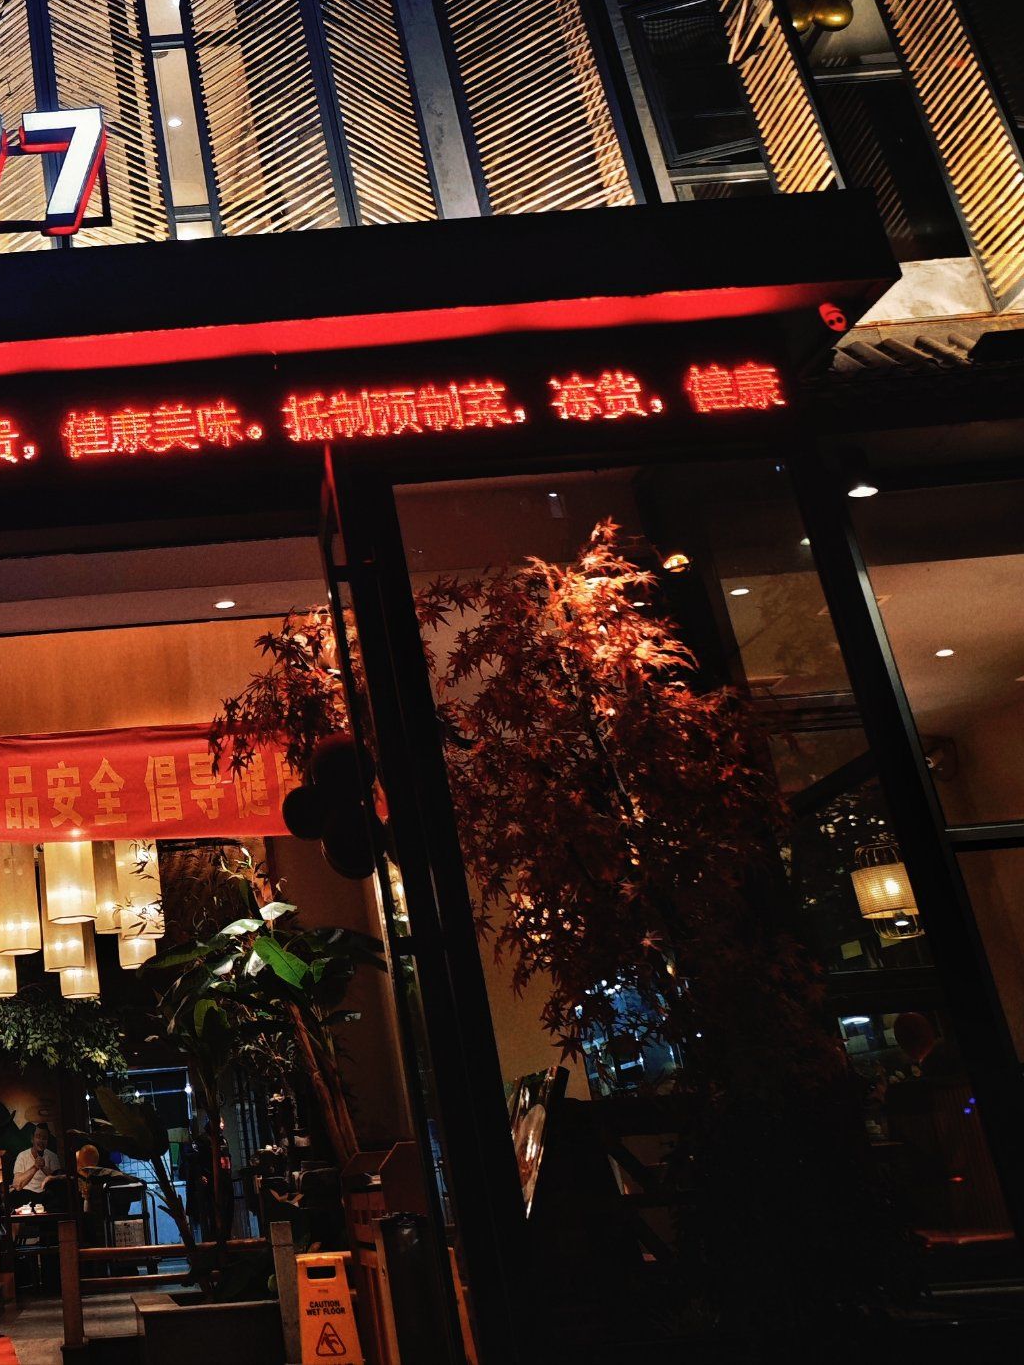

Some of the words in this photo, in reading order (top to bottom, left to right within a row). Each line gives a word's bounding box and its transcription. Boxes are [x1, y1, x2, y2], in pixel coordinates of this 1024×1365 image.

[309, 1300, 340, 1309] CAUTION
[306, 1307, 321, 1316] WET
[322, 1306, 346, 1315] FLOOR
